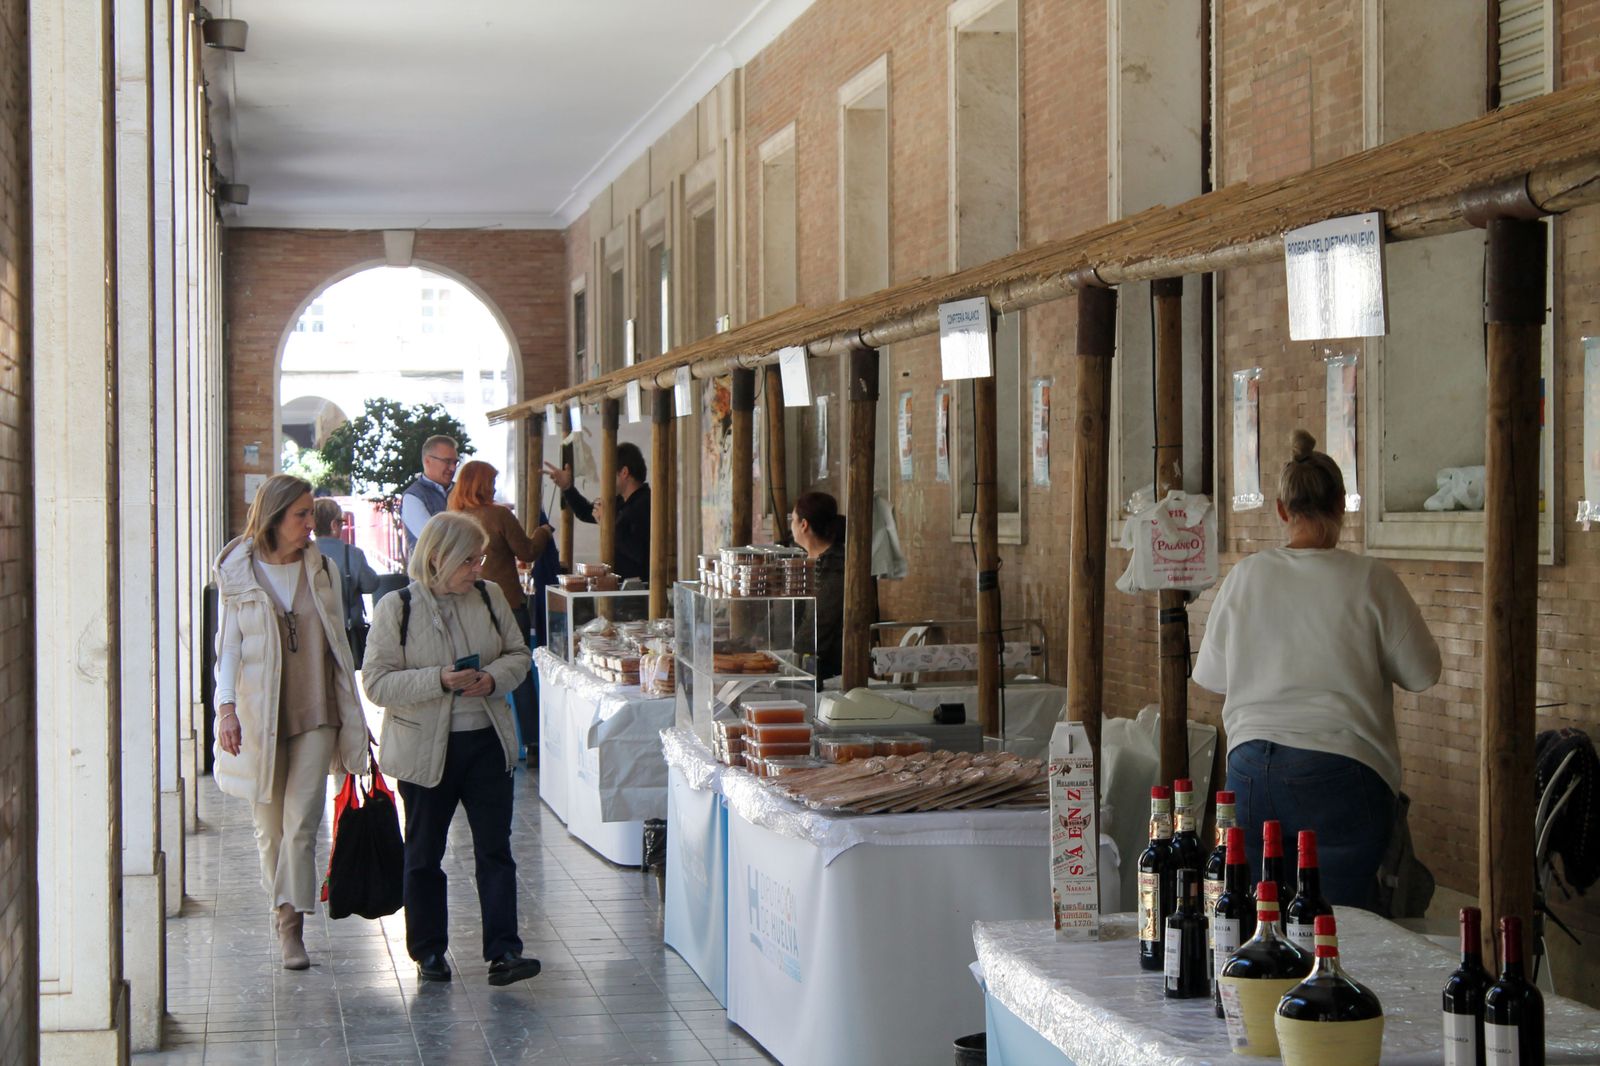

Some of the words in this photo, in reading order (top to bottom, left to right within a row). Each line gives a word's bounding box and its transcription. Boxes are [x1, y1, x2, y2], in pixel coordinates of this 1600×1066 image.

[1287, 239, 1311, 255] BODEGAS
[1312, 237, 1323, 253] DEL
[1350, 230, 1375, 247] NUEVO
[1157, 538, 1200, 551] PALANCO
[771, 911, 799, 959] HUELVA
